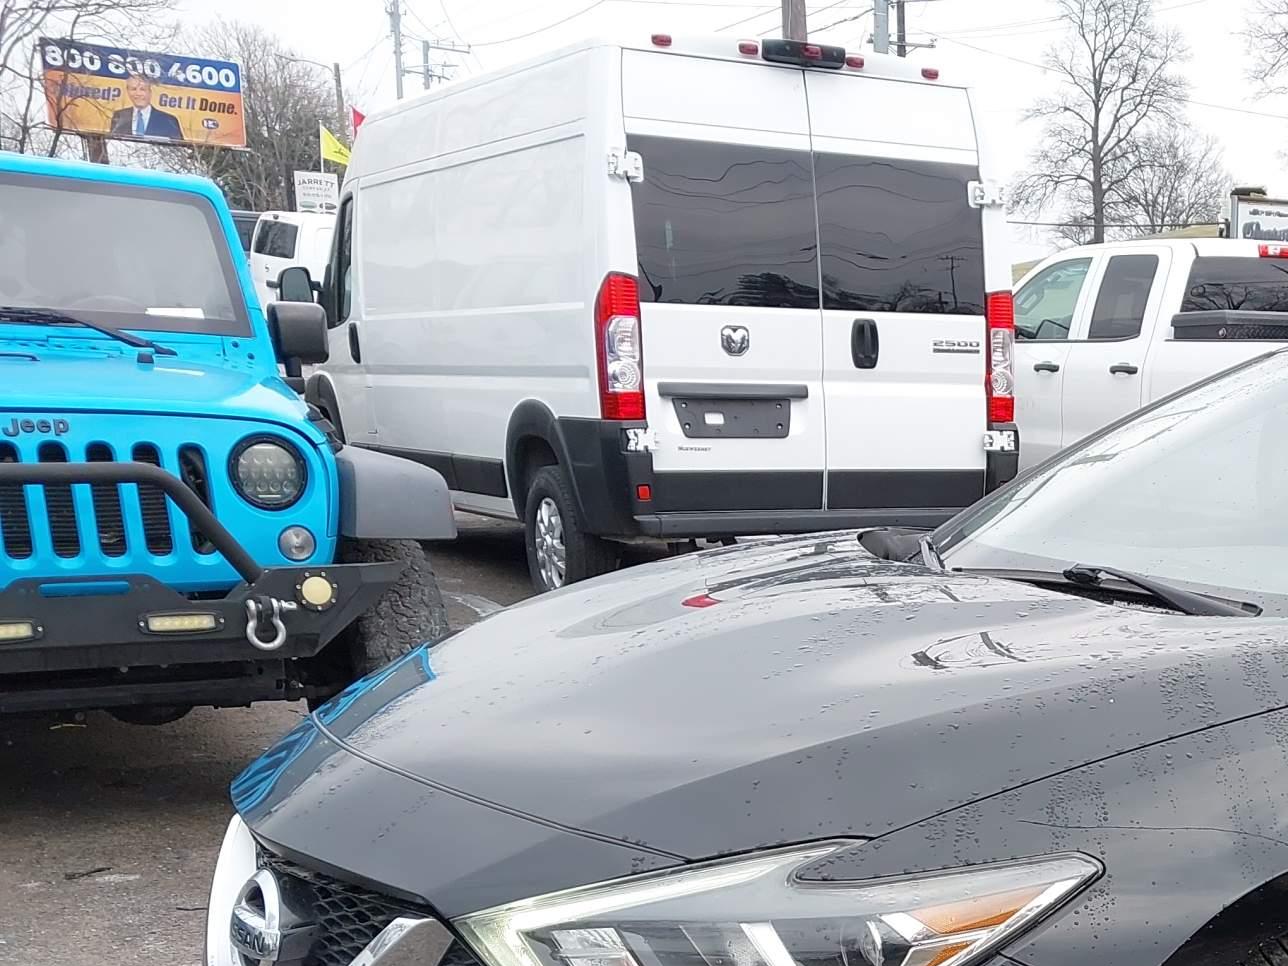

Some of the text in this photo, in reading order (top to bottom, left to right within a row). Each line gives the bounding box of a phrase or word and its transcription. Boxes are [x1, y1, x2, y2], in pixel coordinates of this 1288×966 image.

[45, 45, 101, 71] 800
[168, 62, 235, 87] 4600
[159, 93, 182, 109] Get
[199, 97, 237, 116] Done.
[298, 178, 336, 188] JARRETT
[2, 418, 70, 437] Jeep
